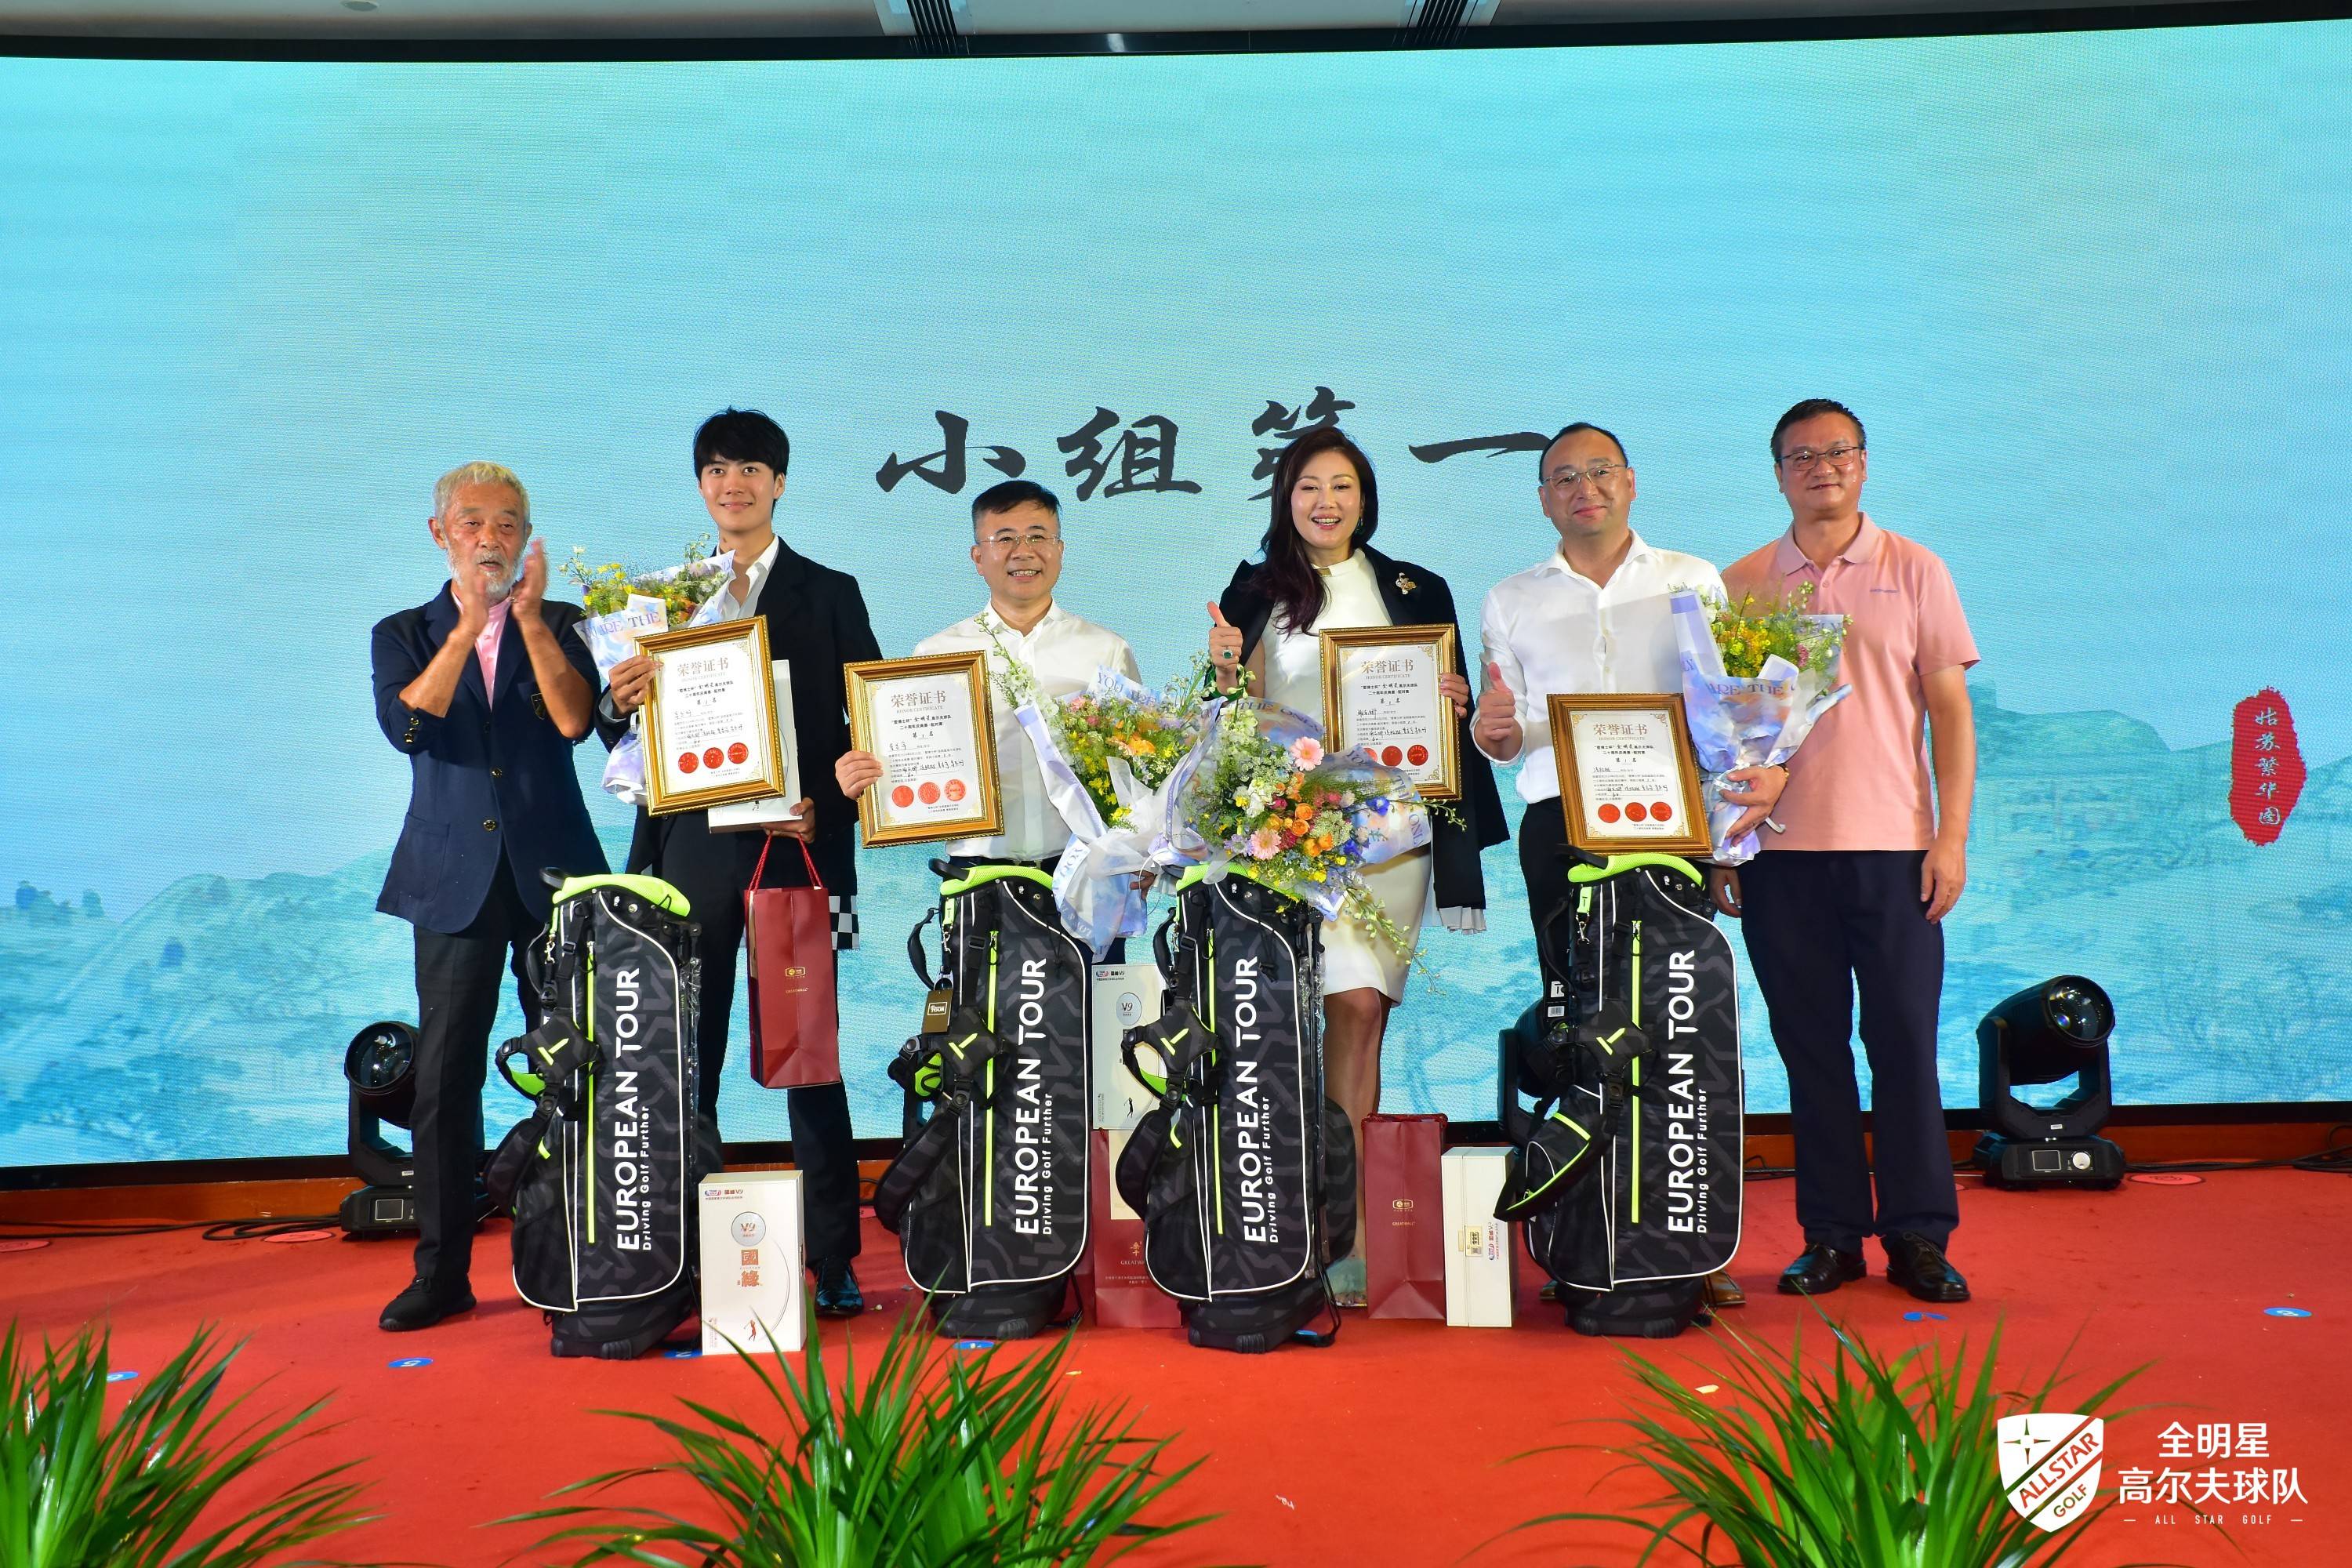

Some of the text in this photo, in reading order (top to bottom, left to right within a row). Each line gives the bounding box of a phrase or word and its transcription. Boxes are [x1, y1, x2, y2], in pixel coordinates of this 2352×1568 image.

[628, 612, 660, 628] THE
[677, 657, 729, 677] 荣誉证书
[891, 690, 946, 708] 荣誉证书
[1361, 659, 1414, 674] 荣誉证书
[1748, 684, 1783, 695] THE
[1593, 724, 1647, 736] 荣誉证书
[1121, 1002, 1133, 1011] V9
[615, 967, 643, 1250] EUROPEAN TOUR
[1014, 958, 1047, 1235] EUROPEAN TOUR
[1236, 956, 1266, 1242] EUROPEAN TOUR
[1668, 949, 1699, 1232] EUROPEAN TOUR
[641, 1105, 652, 1250] Driving Golf Further
[1042, 1093, 1053, 1235] Driving Golf Further
[1261, 1096, 1279, 1243] Driving Golf Further
[1697, 1088, 1709, 1233] Driving Golf Further
[740, 1222, 756, 1232] V9
